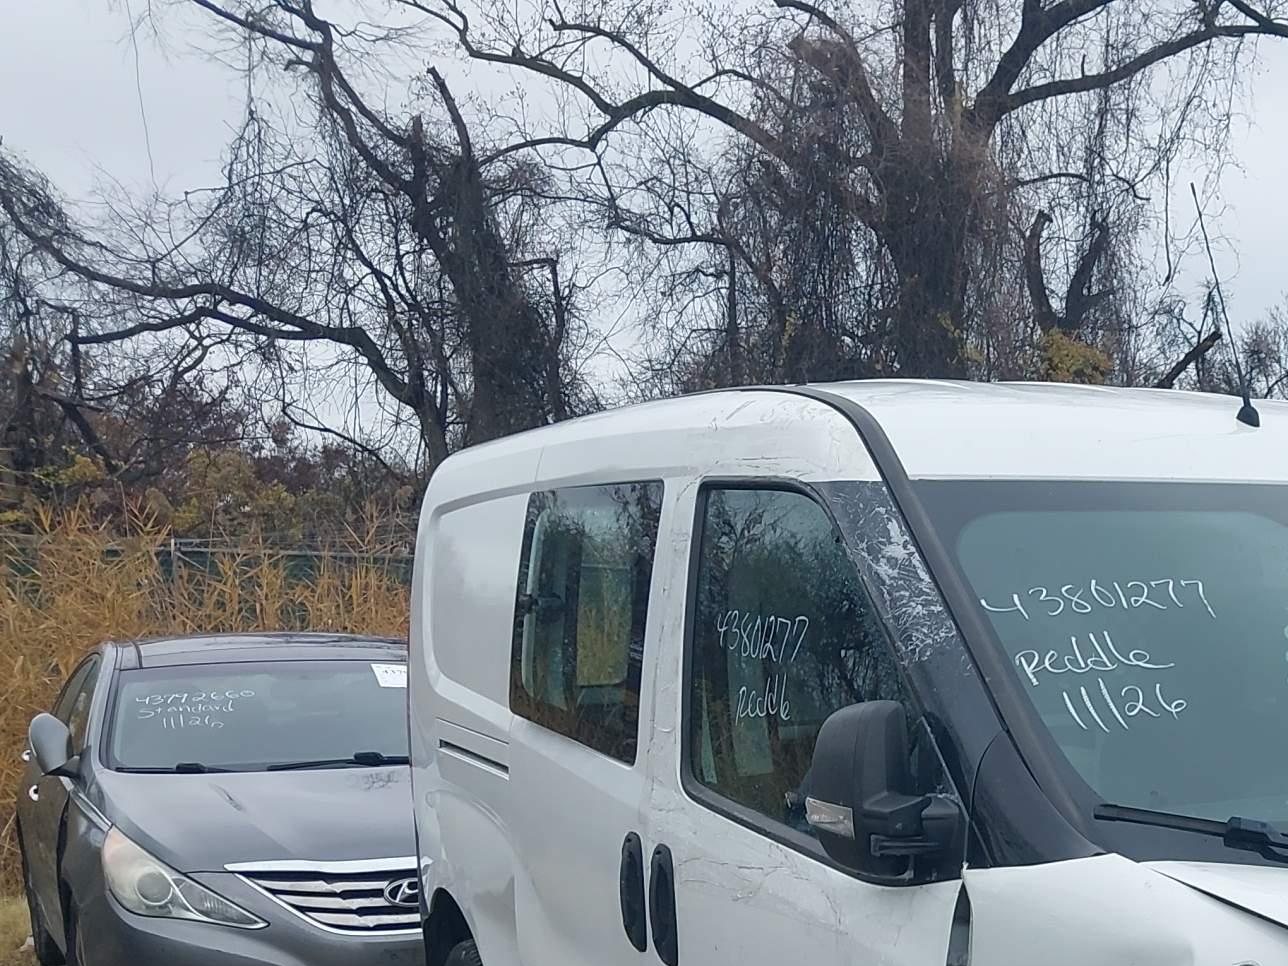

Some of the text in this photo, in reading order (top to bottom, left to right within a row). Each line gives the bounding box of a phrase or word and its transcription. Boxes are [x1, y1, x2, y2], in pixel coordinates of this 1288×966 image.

[980, 578, 1217, 620] 43801277
[716, 609, 809, 665] 43801277
[1062, 677, 1188, 734] 11/26
